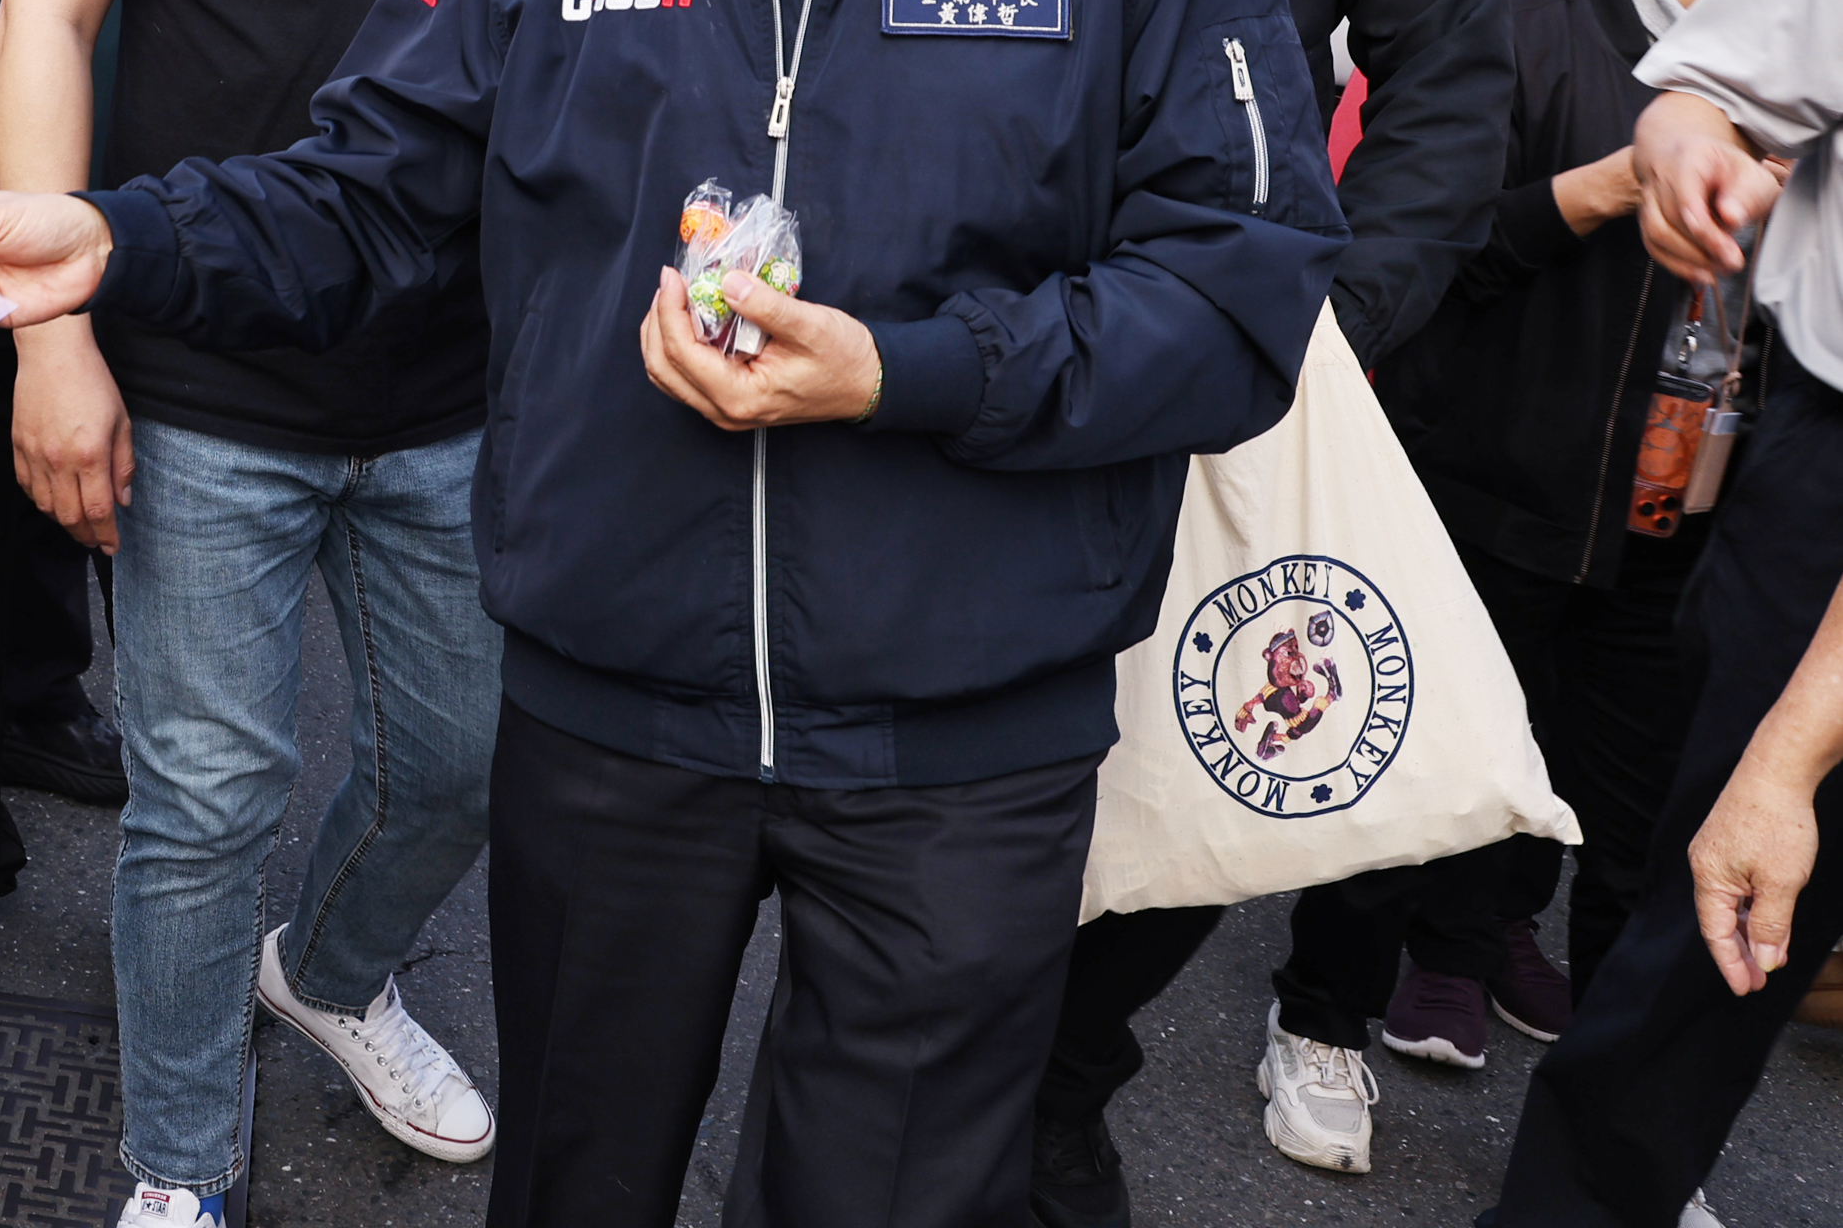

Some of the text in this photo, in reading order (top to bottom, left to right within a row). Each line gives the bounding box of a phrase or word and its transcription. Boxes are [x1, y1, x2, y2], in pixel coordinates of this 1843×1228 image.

[938, 1, 1019, 26] 黃偉哲
[1180, 670, 1290, 812] MONKEY
[1345, 622, 1409, 792] MONKEY
